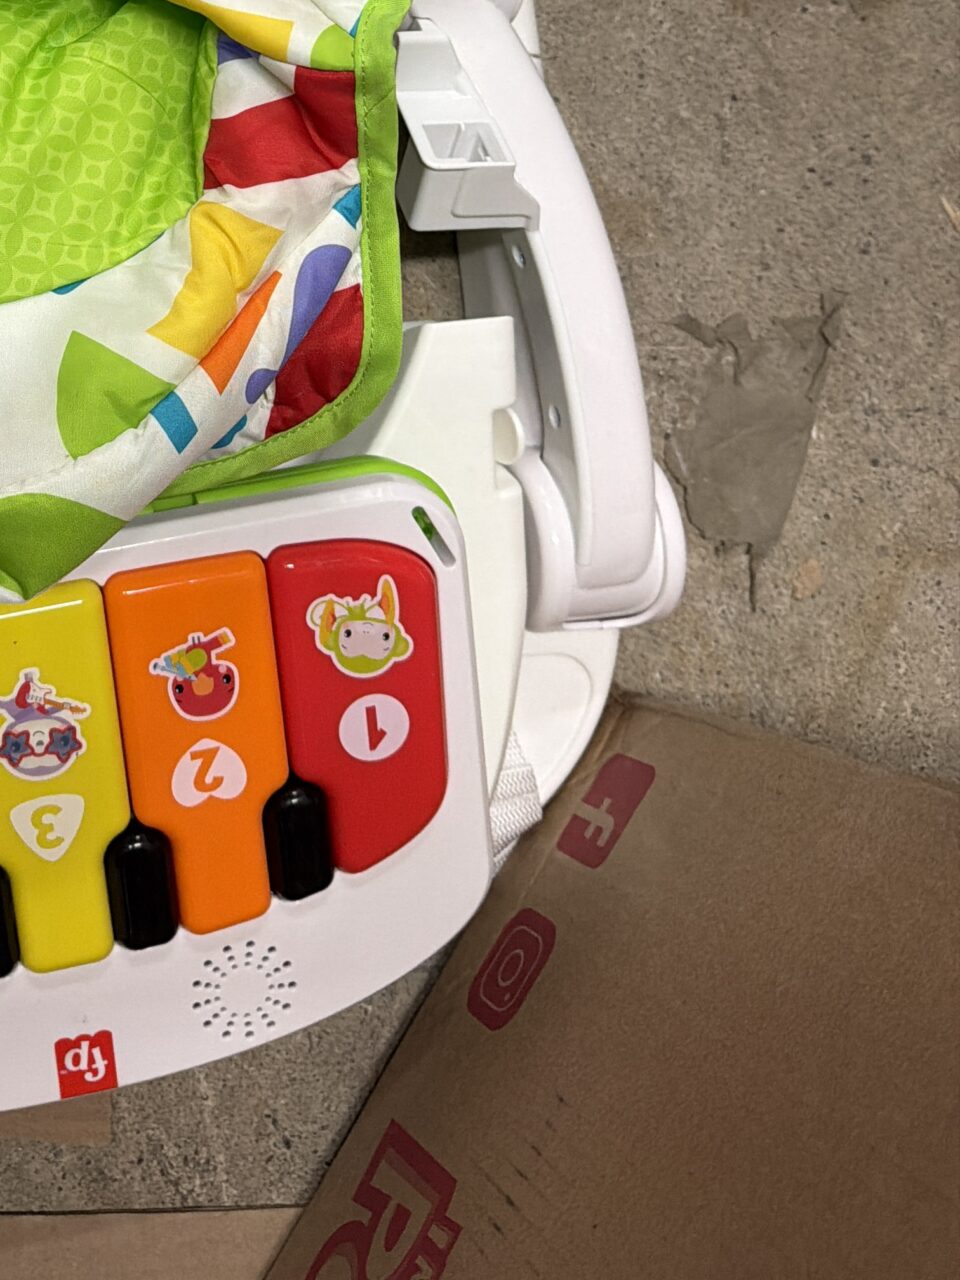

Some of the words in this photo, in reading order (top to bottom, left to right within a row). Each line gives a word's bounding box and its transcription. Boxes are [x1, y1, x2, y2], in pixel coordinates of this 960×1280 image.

[365, 705, 387, 752] 1
[190, 746, 225, 793] 2
[30, 804, 64, 850] 3
[64, 1040, 109, 1083] fp
